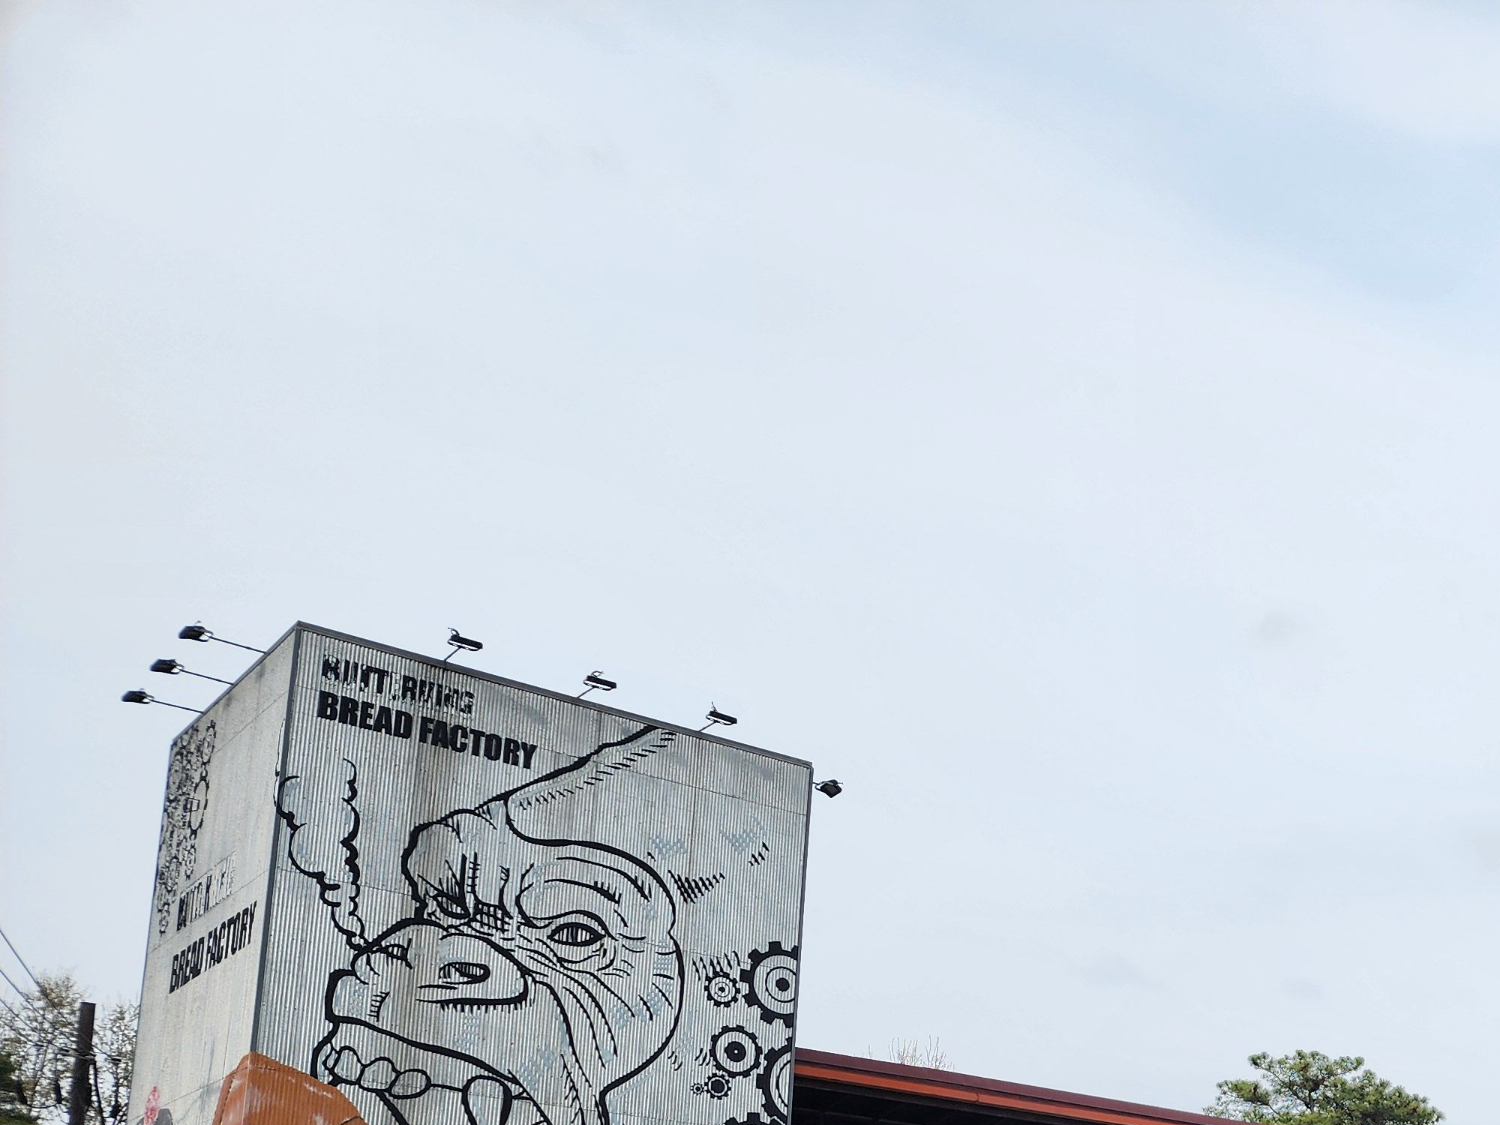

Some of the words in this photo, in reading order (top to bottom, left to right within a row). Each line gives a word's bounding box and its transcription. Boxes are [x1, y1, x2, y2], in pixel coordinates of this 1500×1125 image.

[317, 689, 413, 739] BREAD
[418, 715, 538, 769] FACTORY
[168, 936, 207, 994] BREAD
[205, 900, 258, 972] FACTORY
